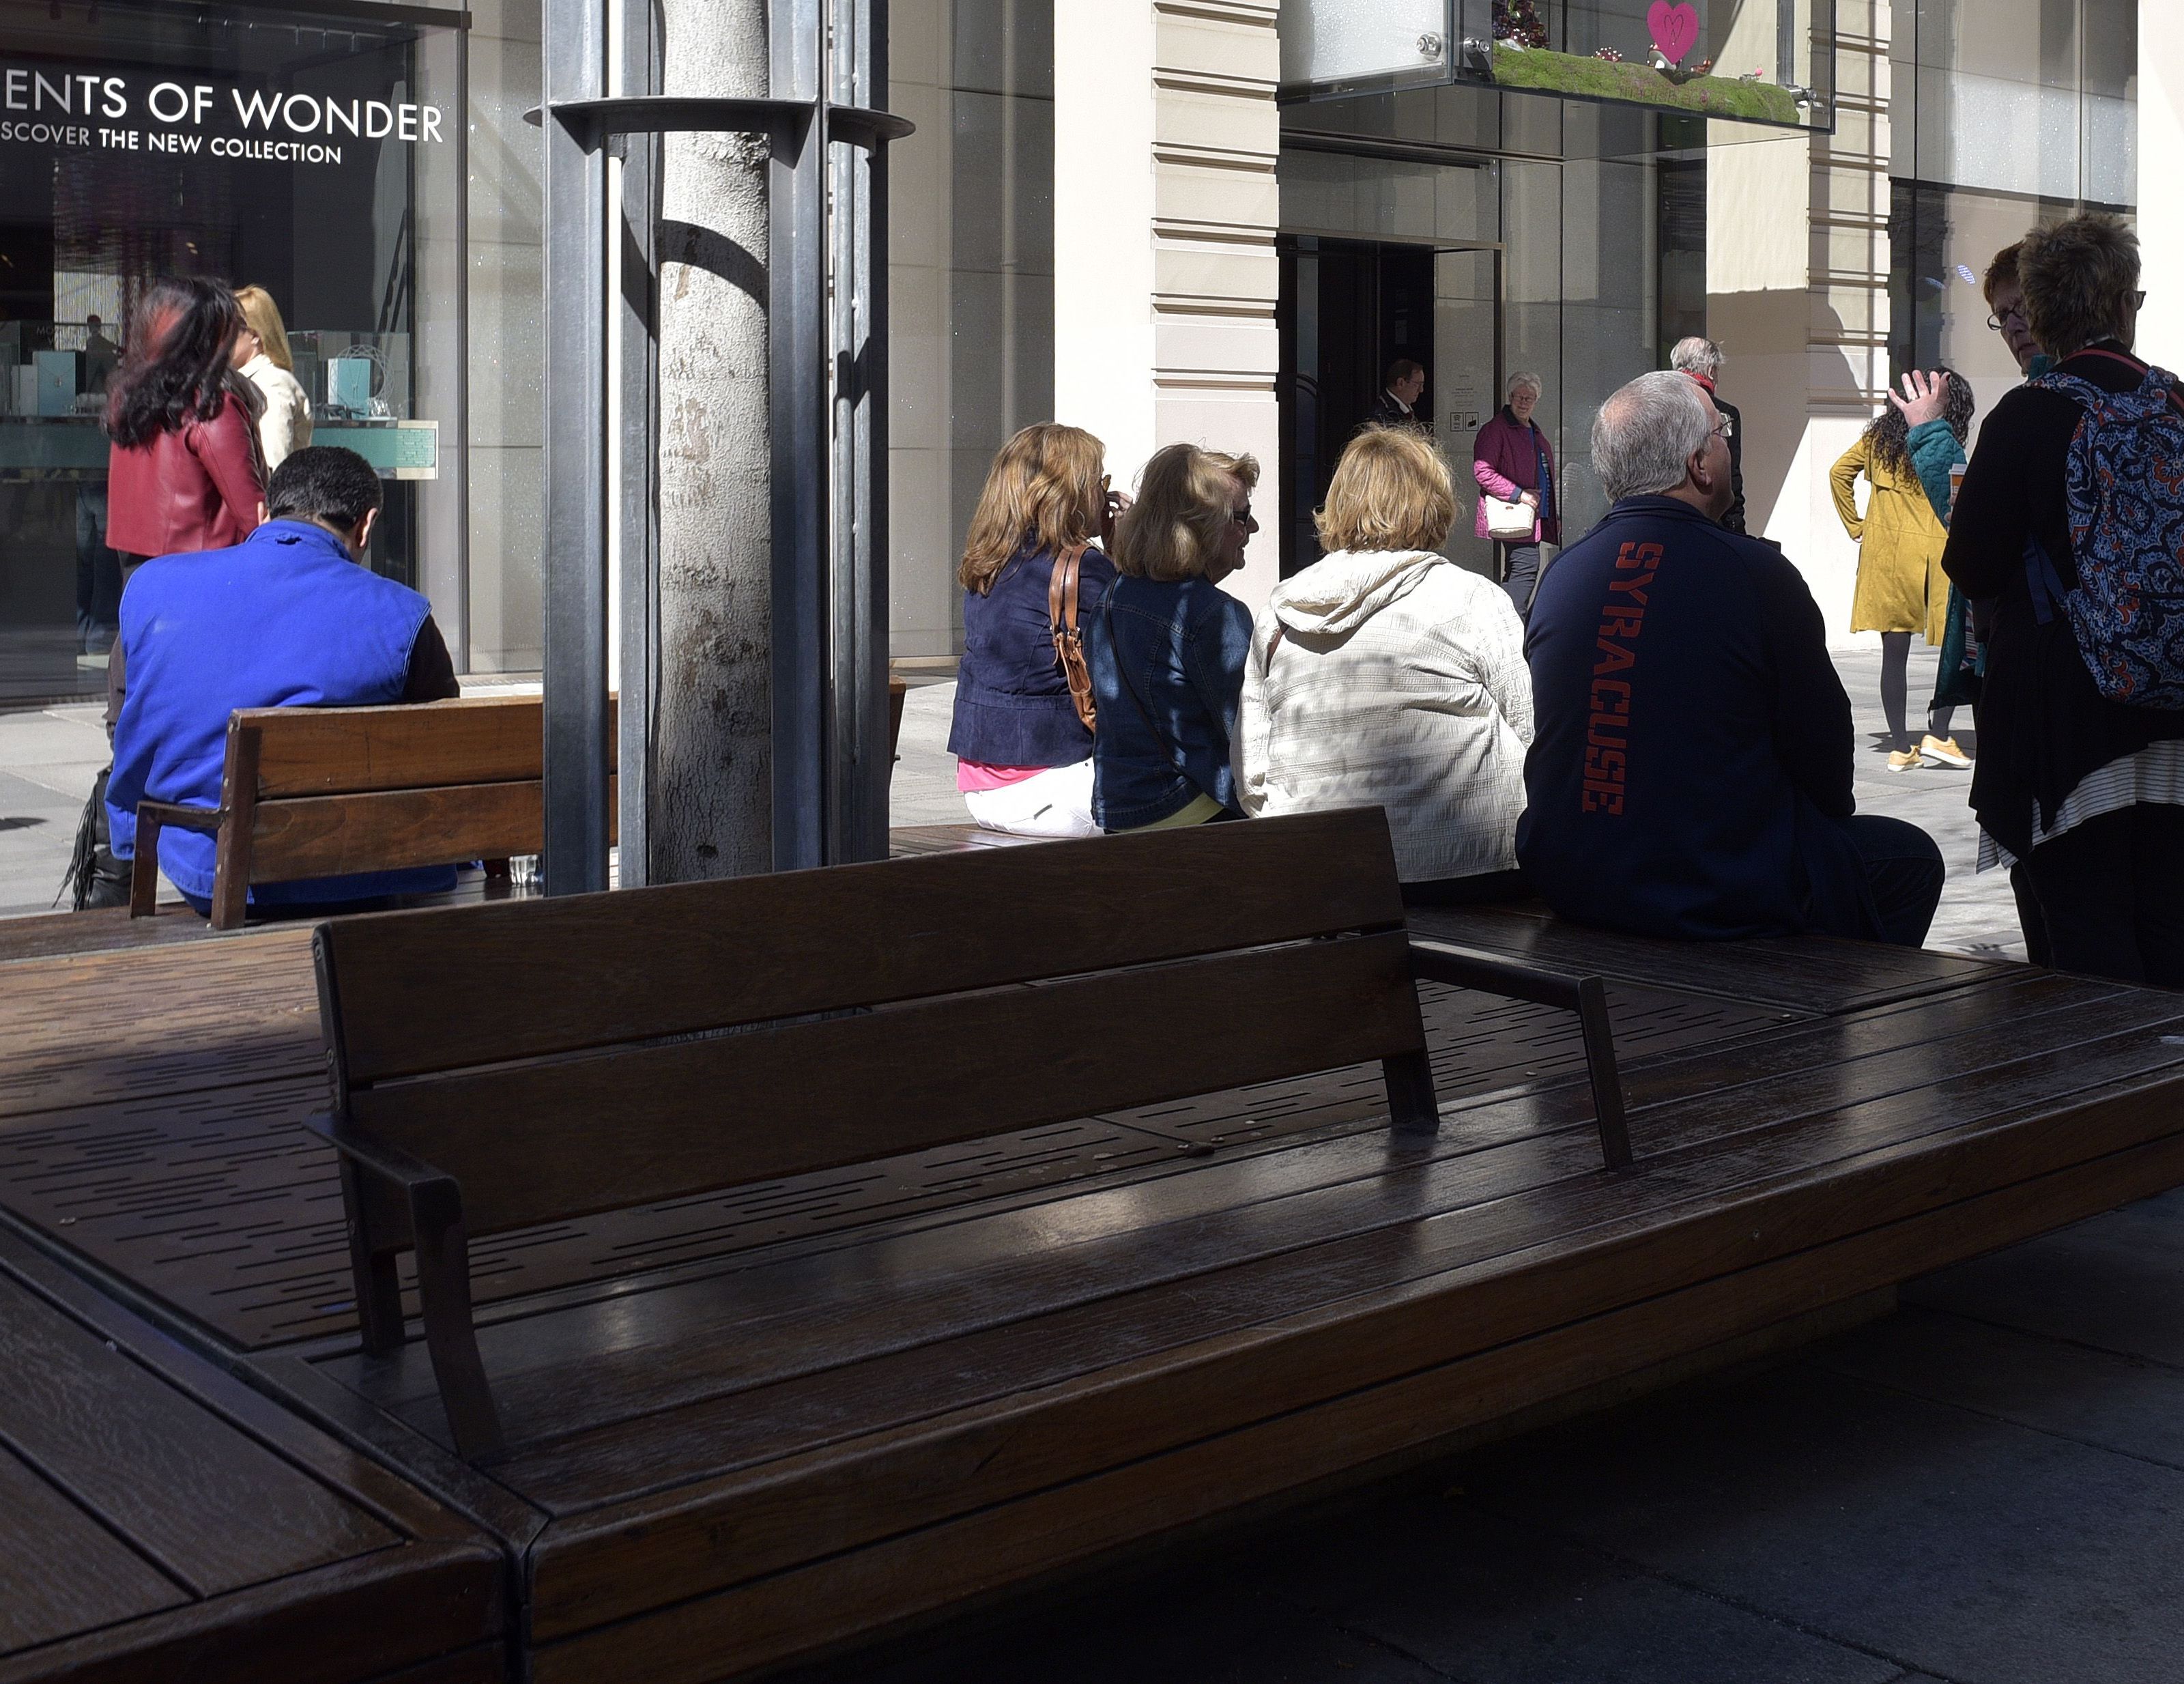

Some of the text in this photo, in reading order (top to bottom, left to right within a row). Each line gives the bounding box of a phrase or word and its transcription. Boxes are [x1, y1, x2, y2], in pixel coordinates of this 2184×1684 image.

[1, 121, 341, 164] SCOVER THE NEW COLLECTION
[6, 69, 443, 143] ENTS OF WONDER
[1582, 541, 1664, 816] SYRACUSE
